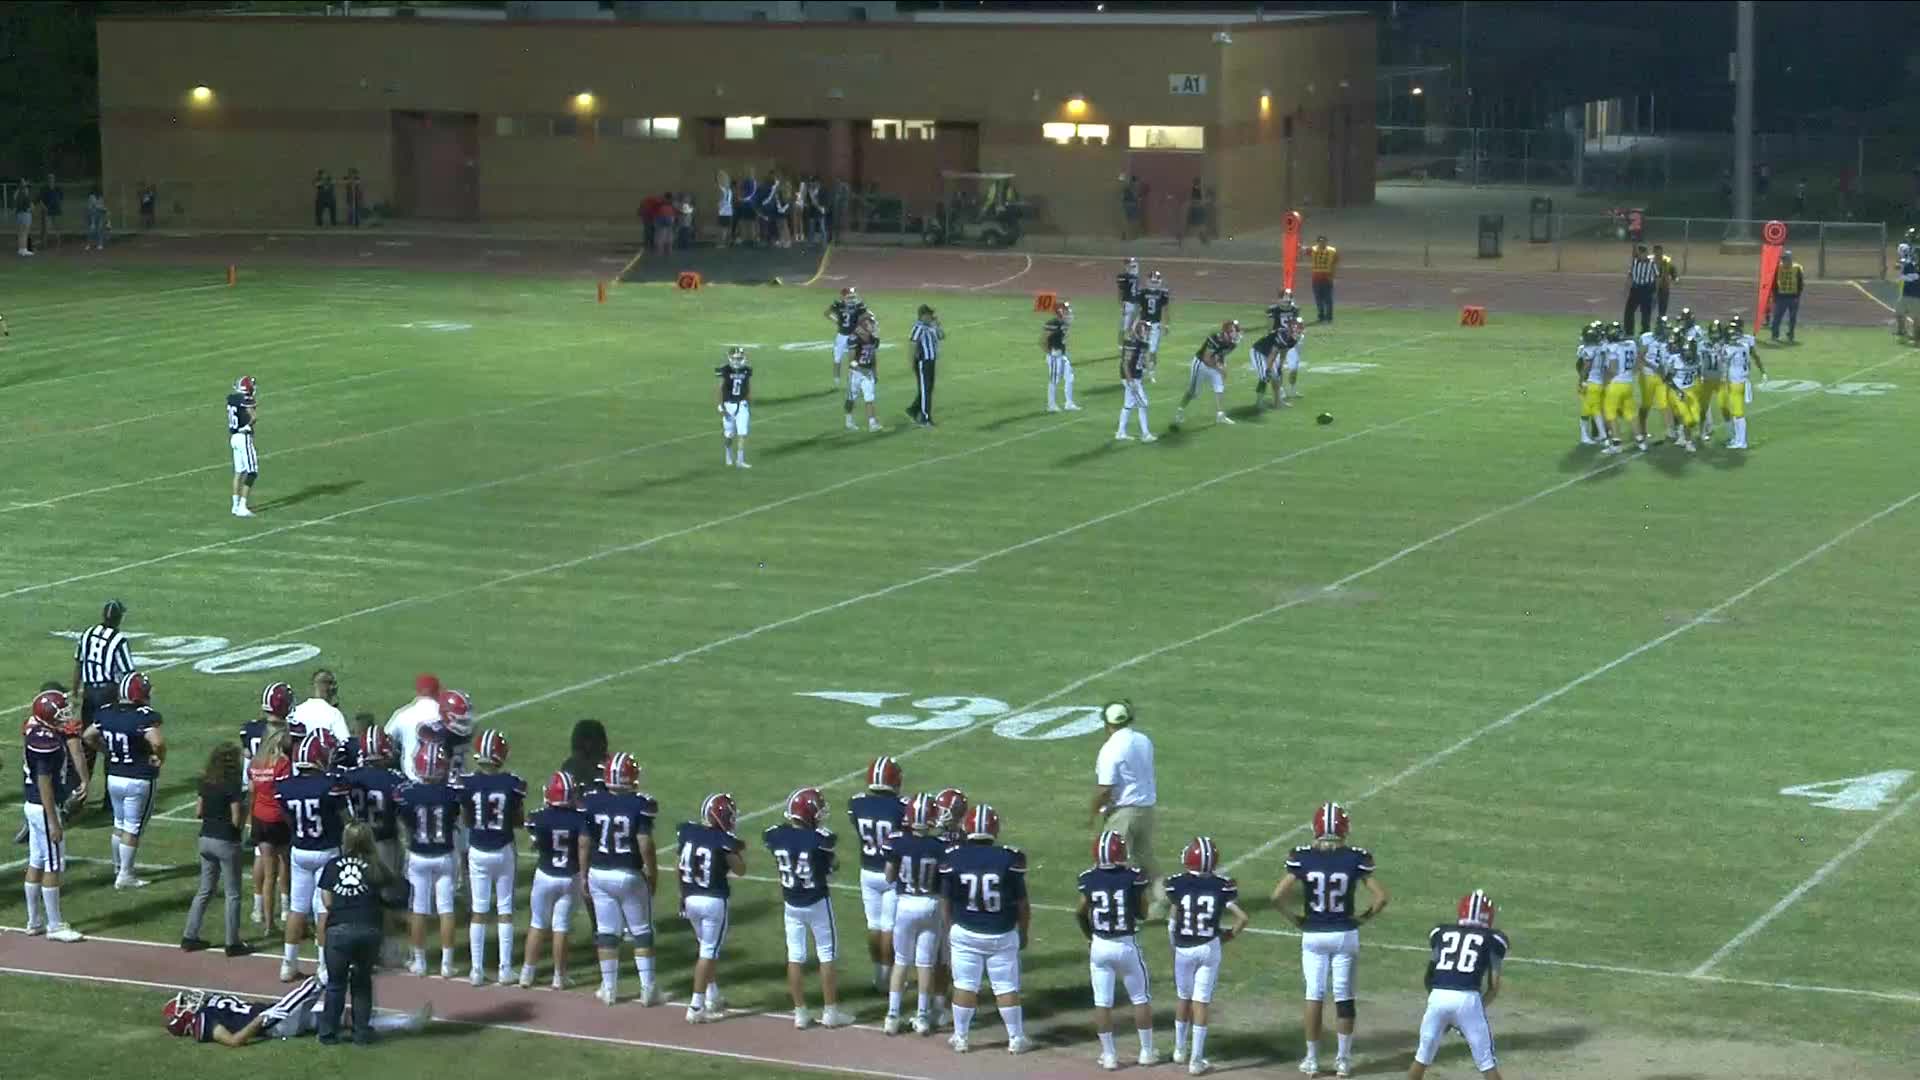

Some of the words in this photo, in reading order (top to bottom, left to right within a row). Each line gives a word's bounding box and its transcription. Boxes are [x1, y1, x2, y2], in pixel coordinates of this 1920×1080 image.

[1184, 76, 1200, 92] A1
[1462, 308, 1480, 325] 20
[90, 634, 106, 665] H
[866, 696, 1104, 740] 30
[103, 730, 133, 764] 77
[1778, 769, 1916, 811] 4
[287, 798, 322, 838] 75
[415, 804, 445, 844] 11
[471, 791, 506, 830] 13
[552, 829, 569, 868] 5
[594, 814, 631, 854] 72
[678, 842, 712, 888] 43
[899, 856, 938, 893] 40
[960, 873, 1000, 912] 76
[1091, 889, 1127, 931] 21
[1306, 871, 1349, 913] 32
[1180, 894, 1215, 936] 12
[1436, 931, 1484, 973] 26
